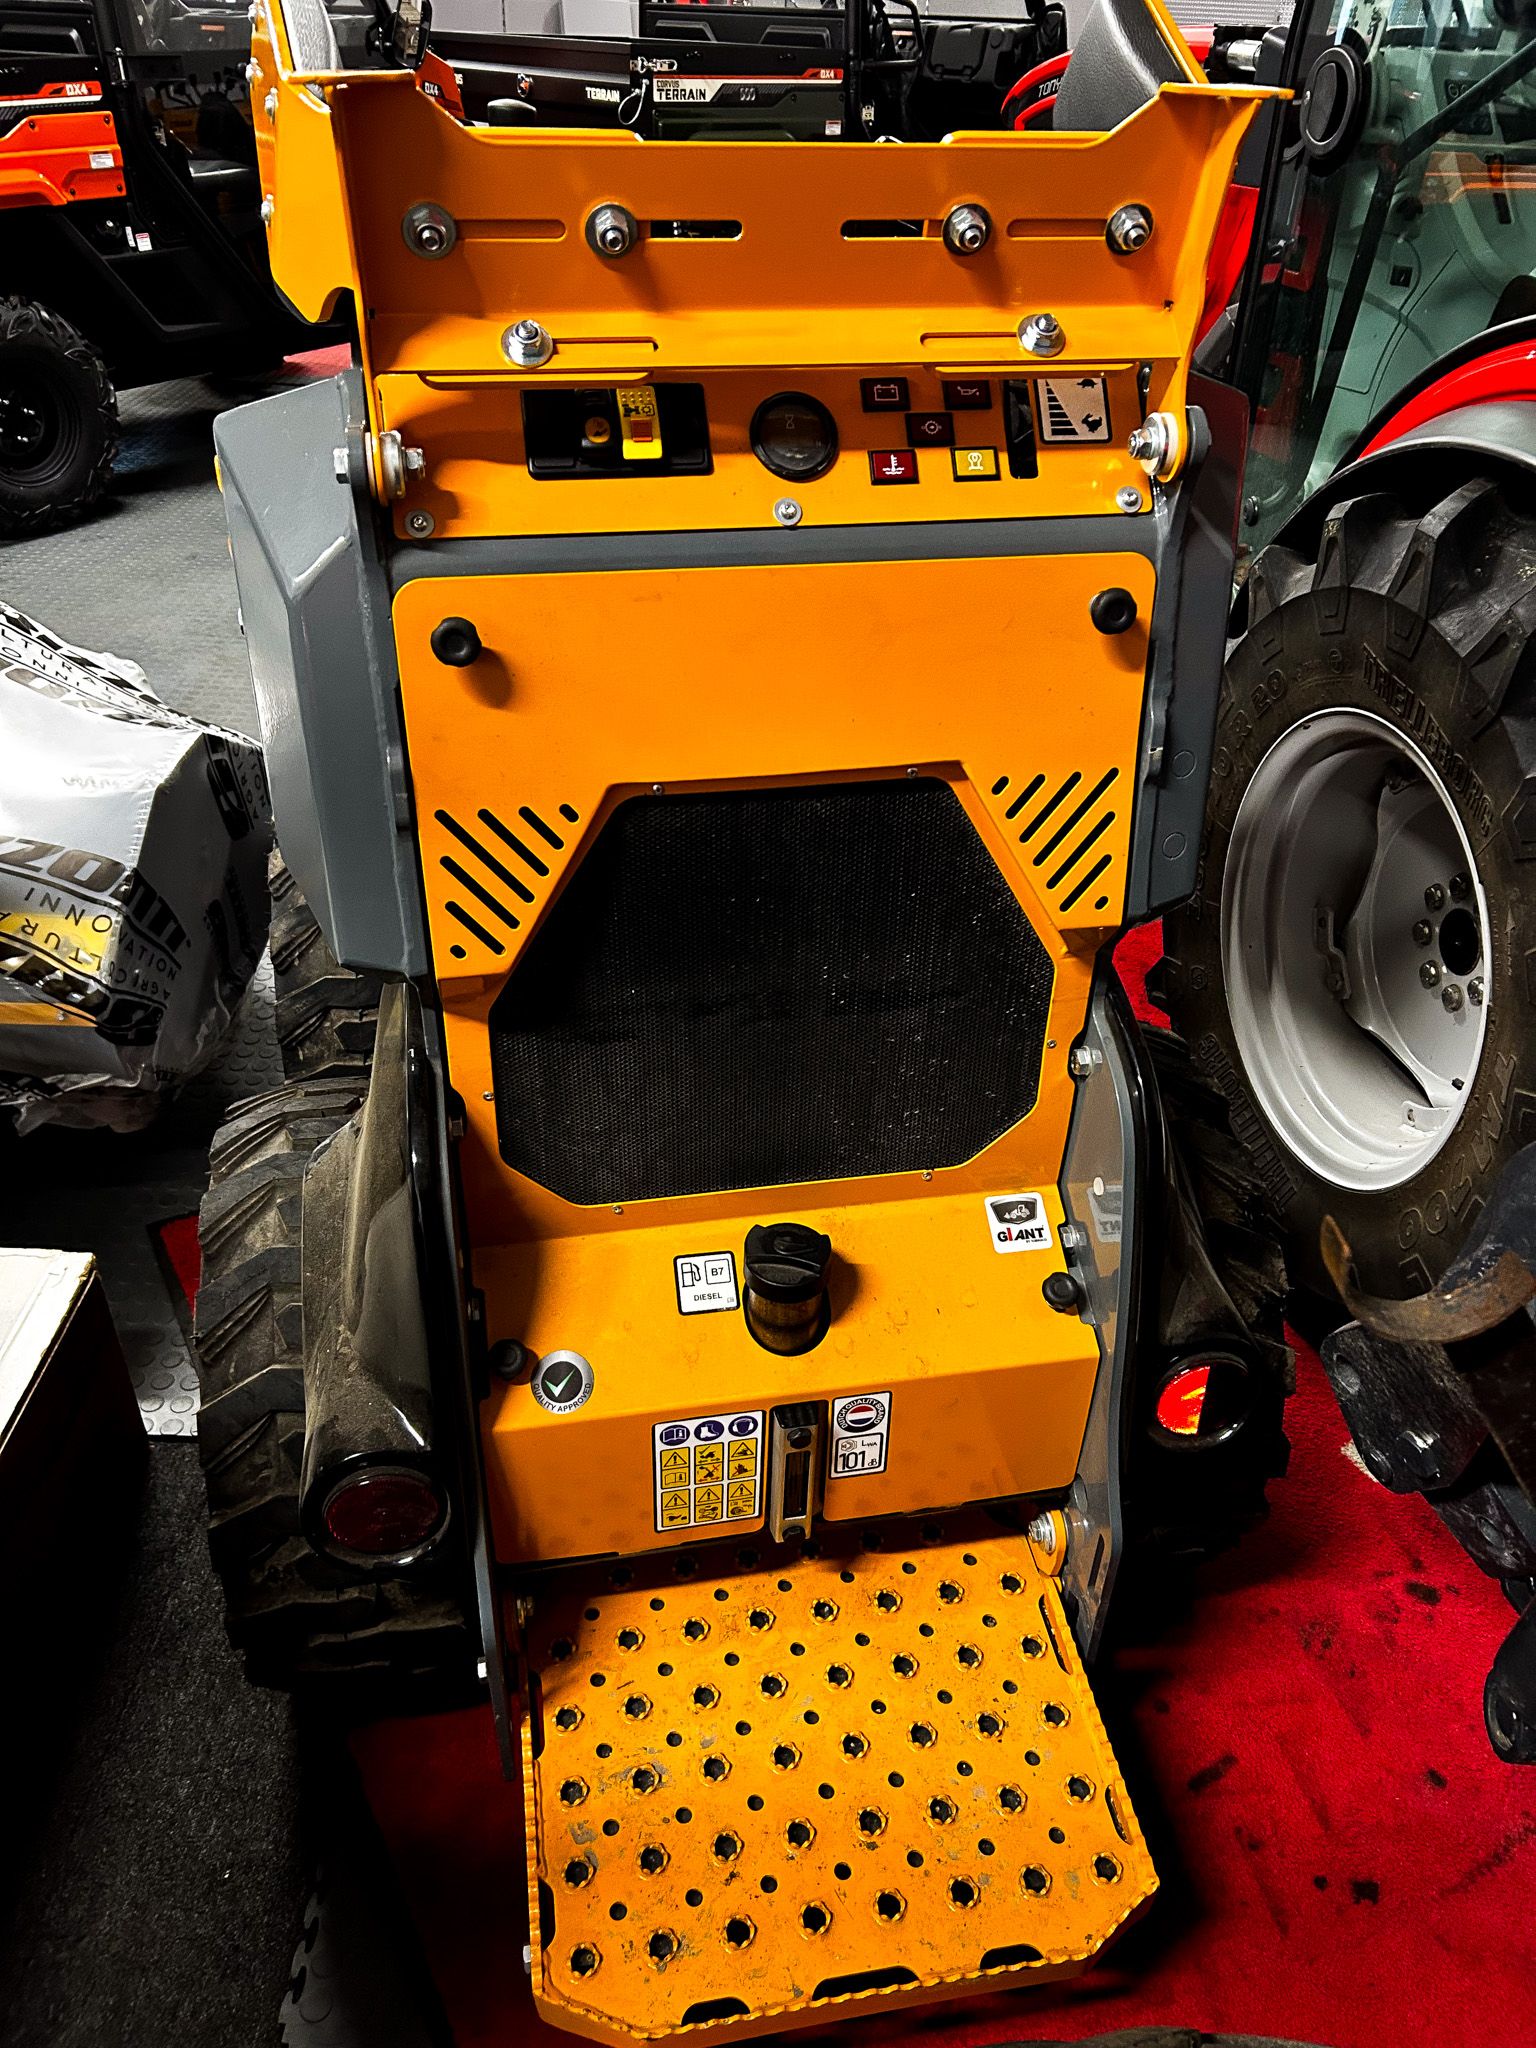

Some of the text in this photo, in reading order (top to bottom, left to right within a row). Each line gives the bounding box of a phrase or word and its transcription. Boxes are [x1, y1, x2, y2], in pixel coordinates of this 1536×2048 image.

[65, 82, 89, 96] DX4
[656, 80, 680, 88] CORVUS
[585, 86, 620, 103] TERRAIN
[656, 88, 706, 101] TERRAIN
[997, 1226, 1044, 1243] GIANT
[711, 1267, 724, 1277] B7
[693, 1292, 723, 1301] DIESEL
[534, 1383, 591, 1412] QUALITY APPROVED
[838, 1398, 885, 1429] DUTCH QUALITY BRAND
[839, 1450, 866, 1470] 101
